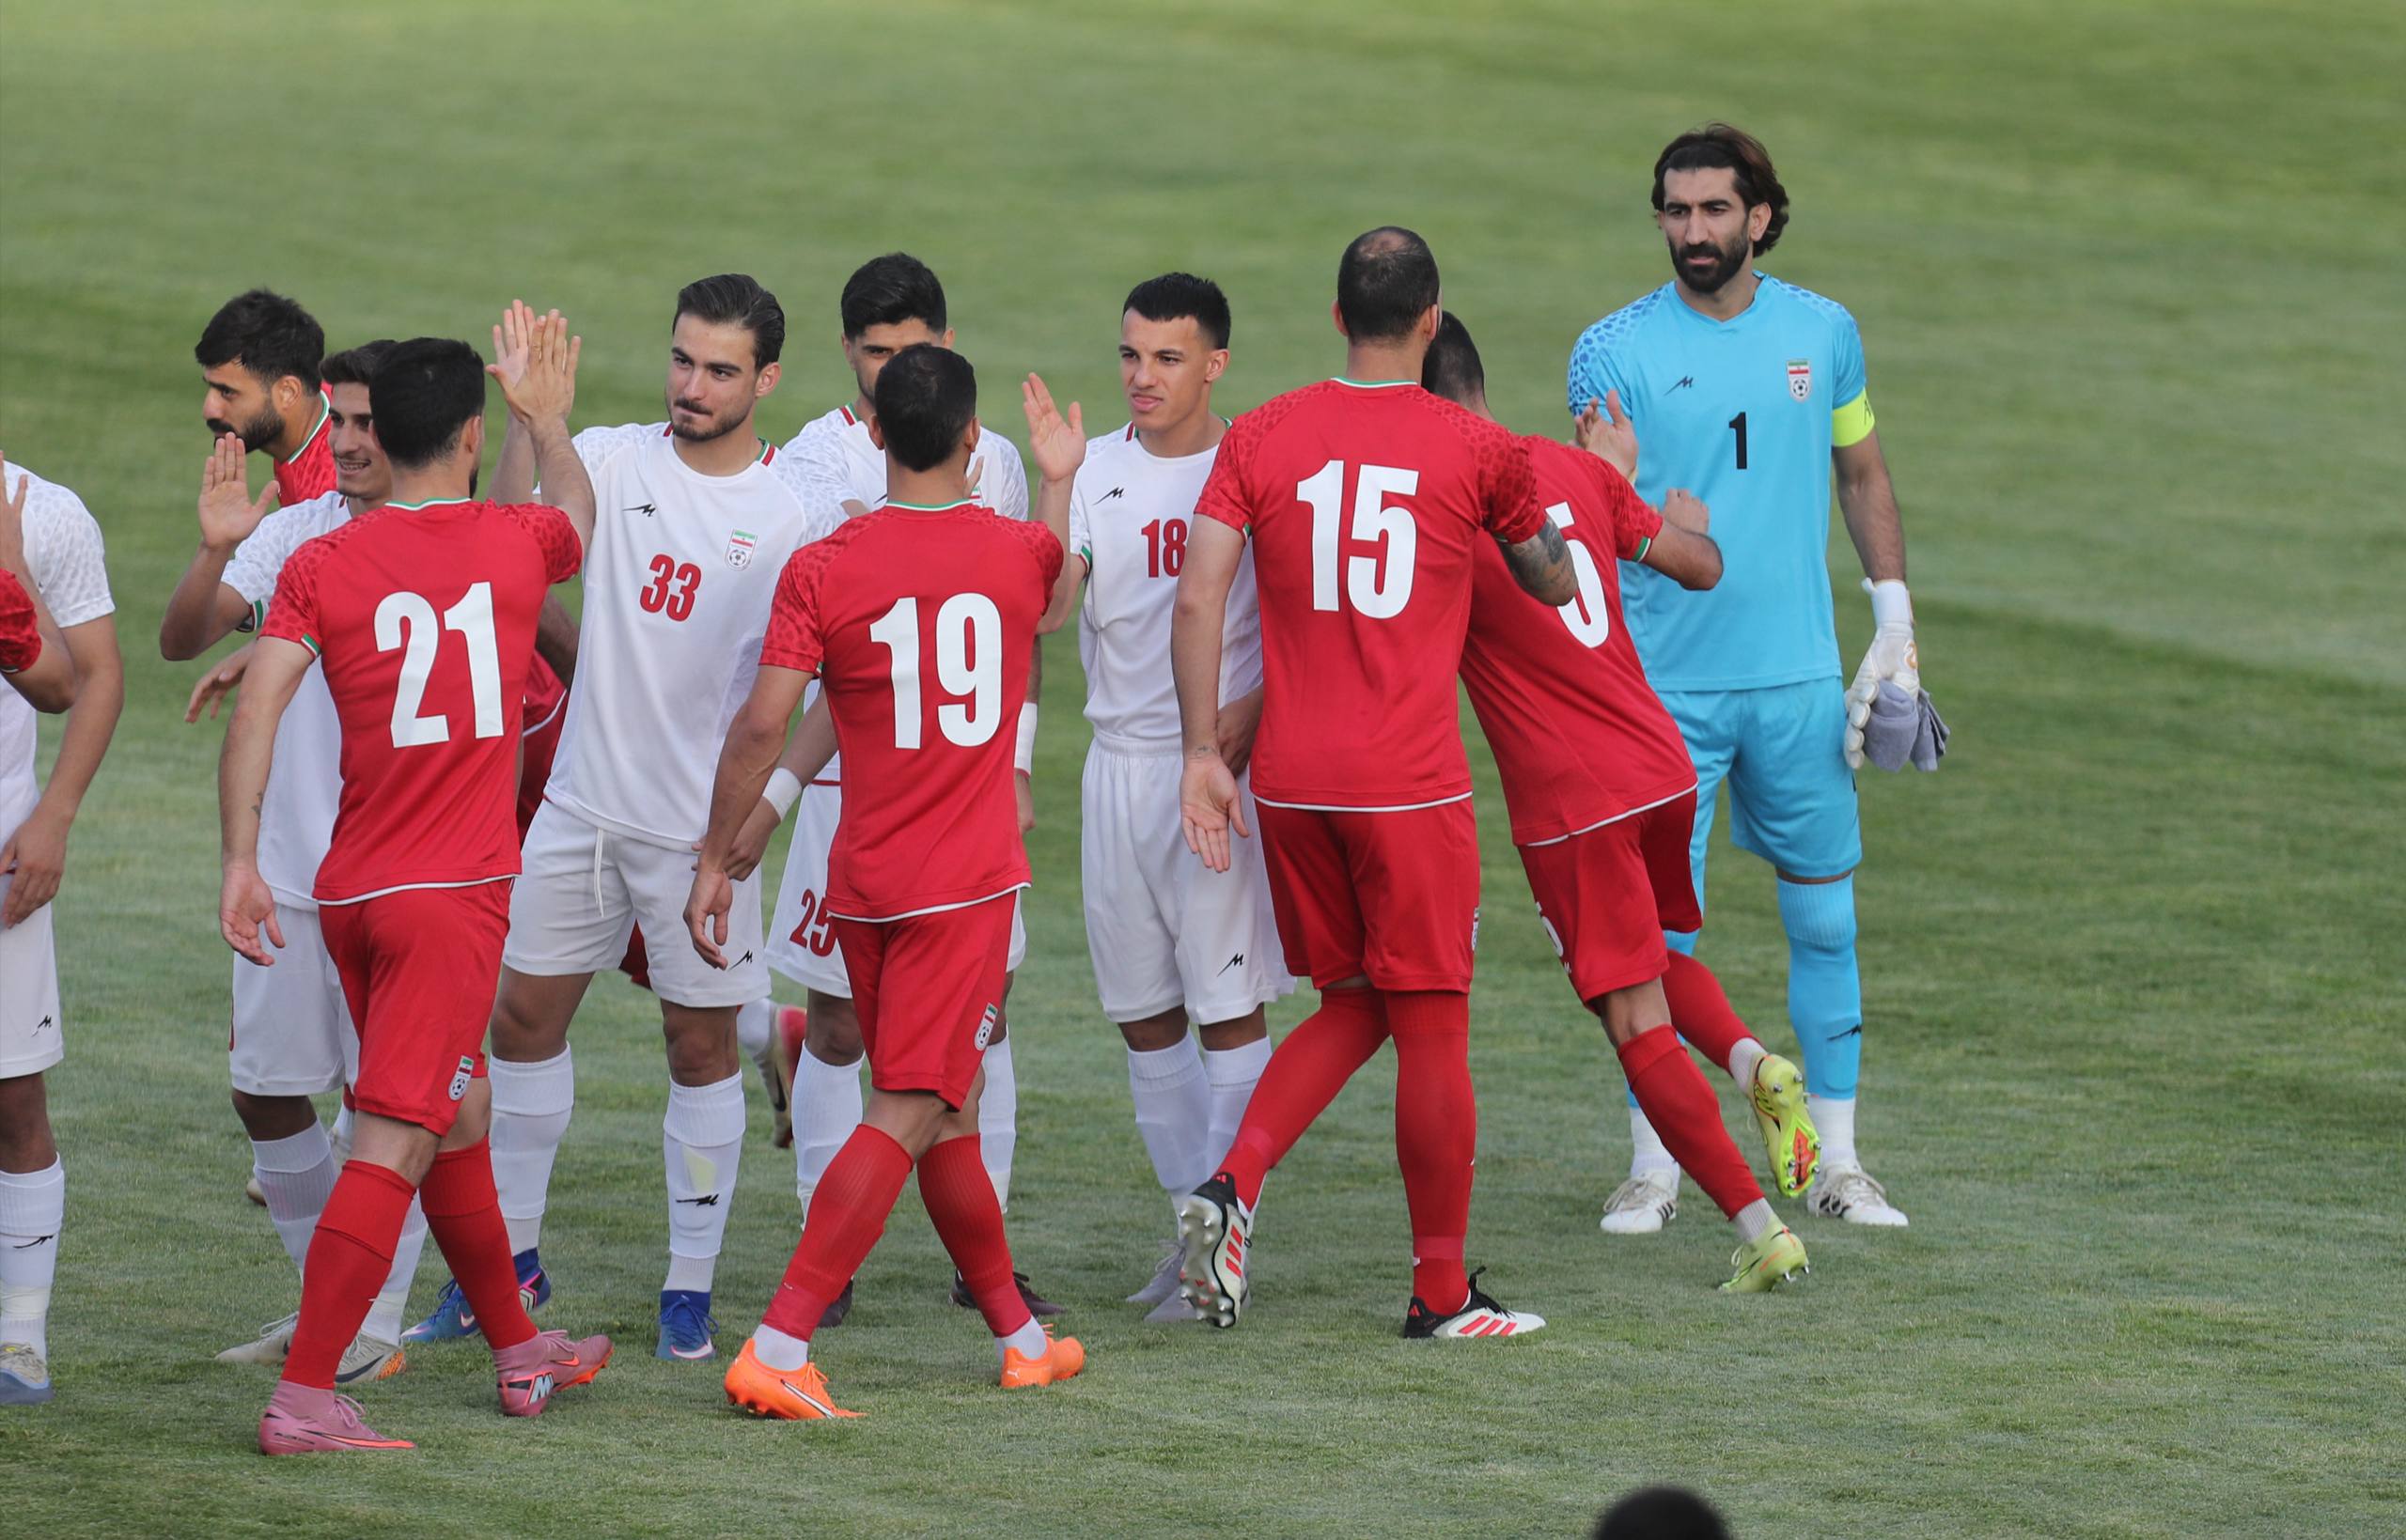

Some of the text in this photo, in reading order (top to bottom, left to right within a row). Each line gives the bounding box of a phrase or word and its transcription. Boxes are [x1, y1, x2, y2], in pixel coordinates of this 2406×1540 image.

[1728, 412, 1747, 470] 1
[639, 553, 702, 622] 33
[1140, 518, 1188, 578] 18
[1296, 459, 1420, 619] 15
[1544, 501, 1610, 649] 5
[373, 581, 505, 749] 21
[869, 592, 1002, 750] 19
[789, 888, 837, 957] 25
